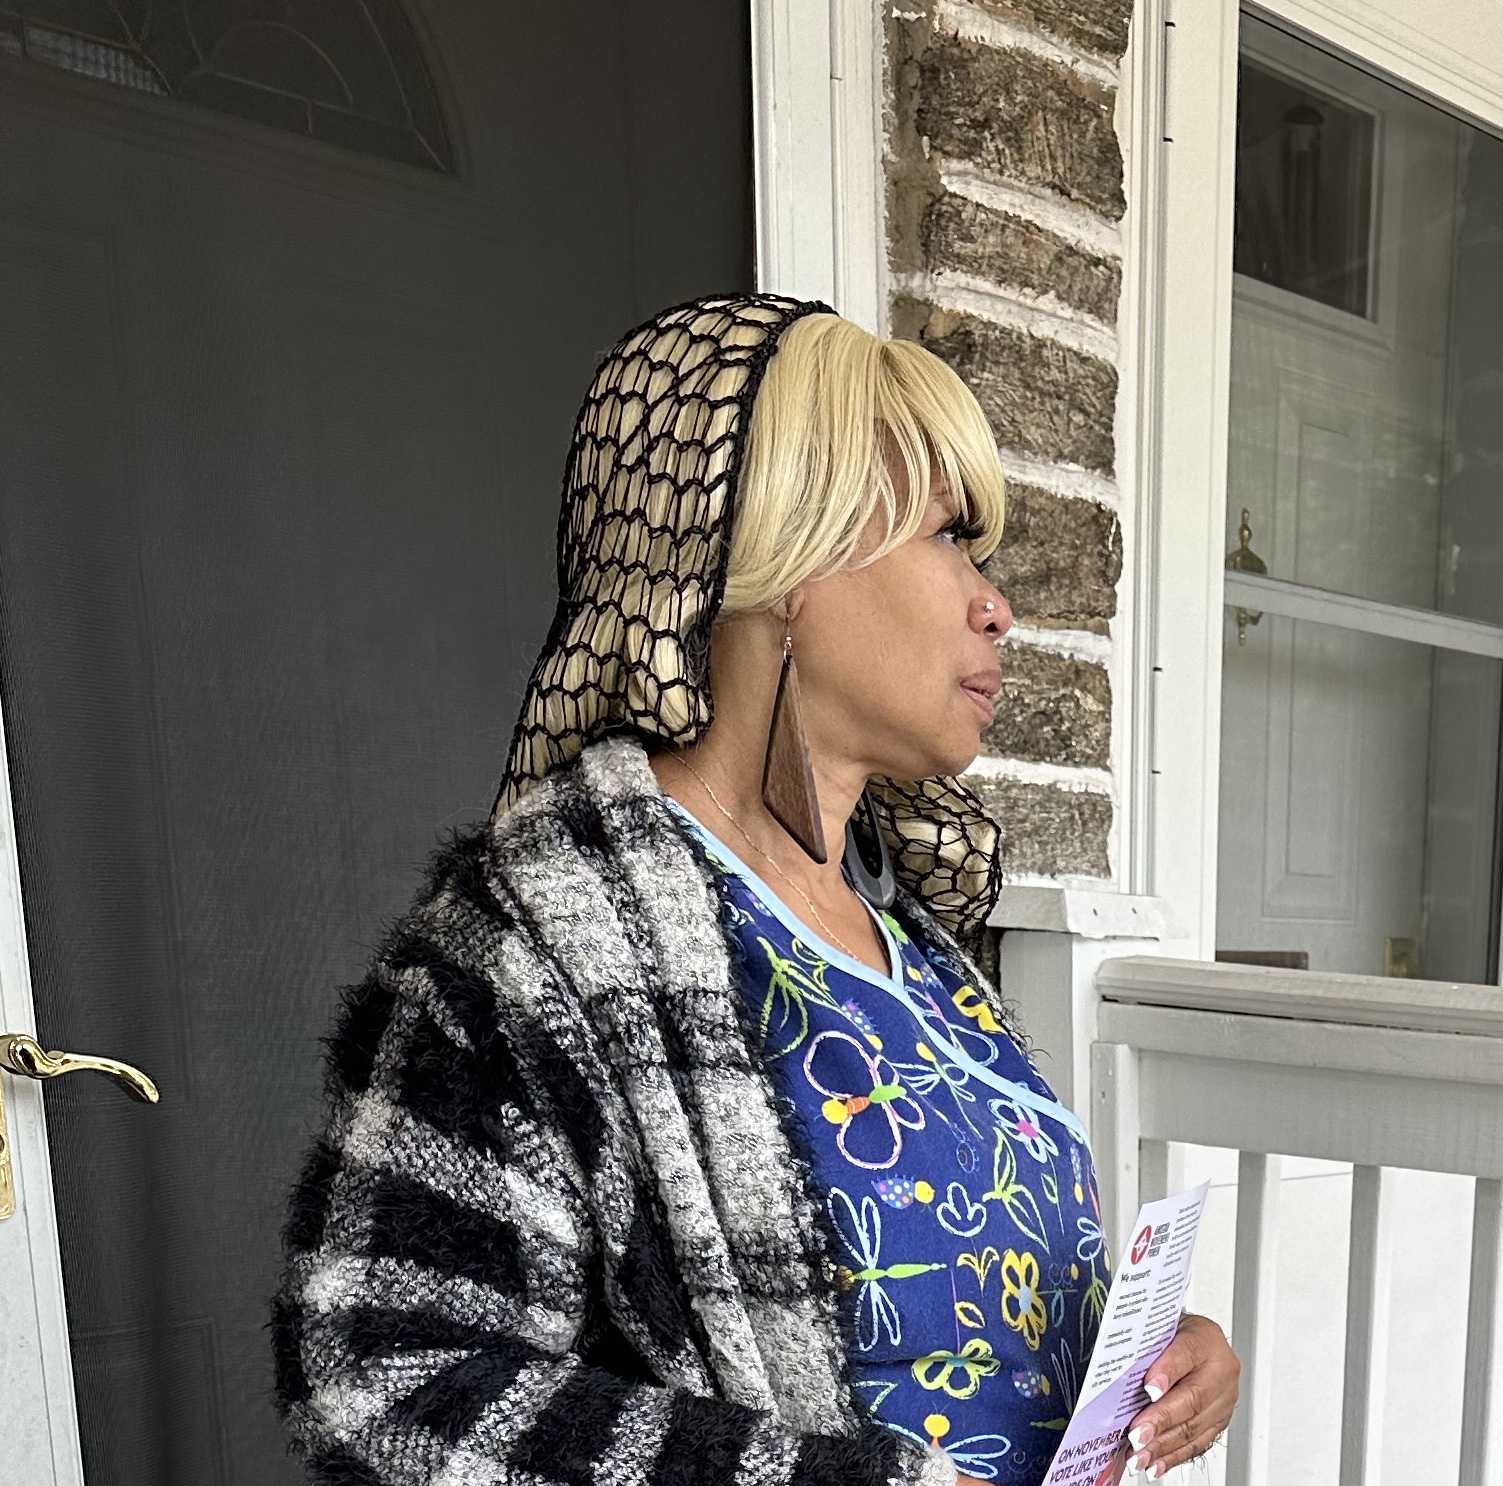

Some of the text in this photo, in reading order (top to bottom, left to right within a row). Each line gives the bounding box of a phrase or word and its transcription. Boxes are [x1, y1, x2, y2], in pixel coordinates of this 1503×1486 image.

[1058, 1446, 1075, 1464] ON
[1073, 1429, 1122, 1458] NOVEMBER
[1049, 1464, 1074, 1485] VOTE
